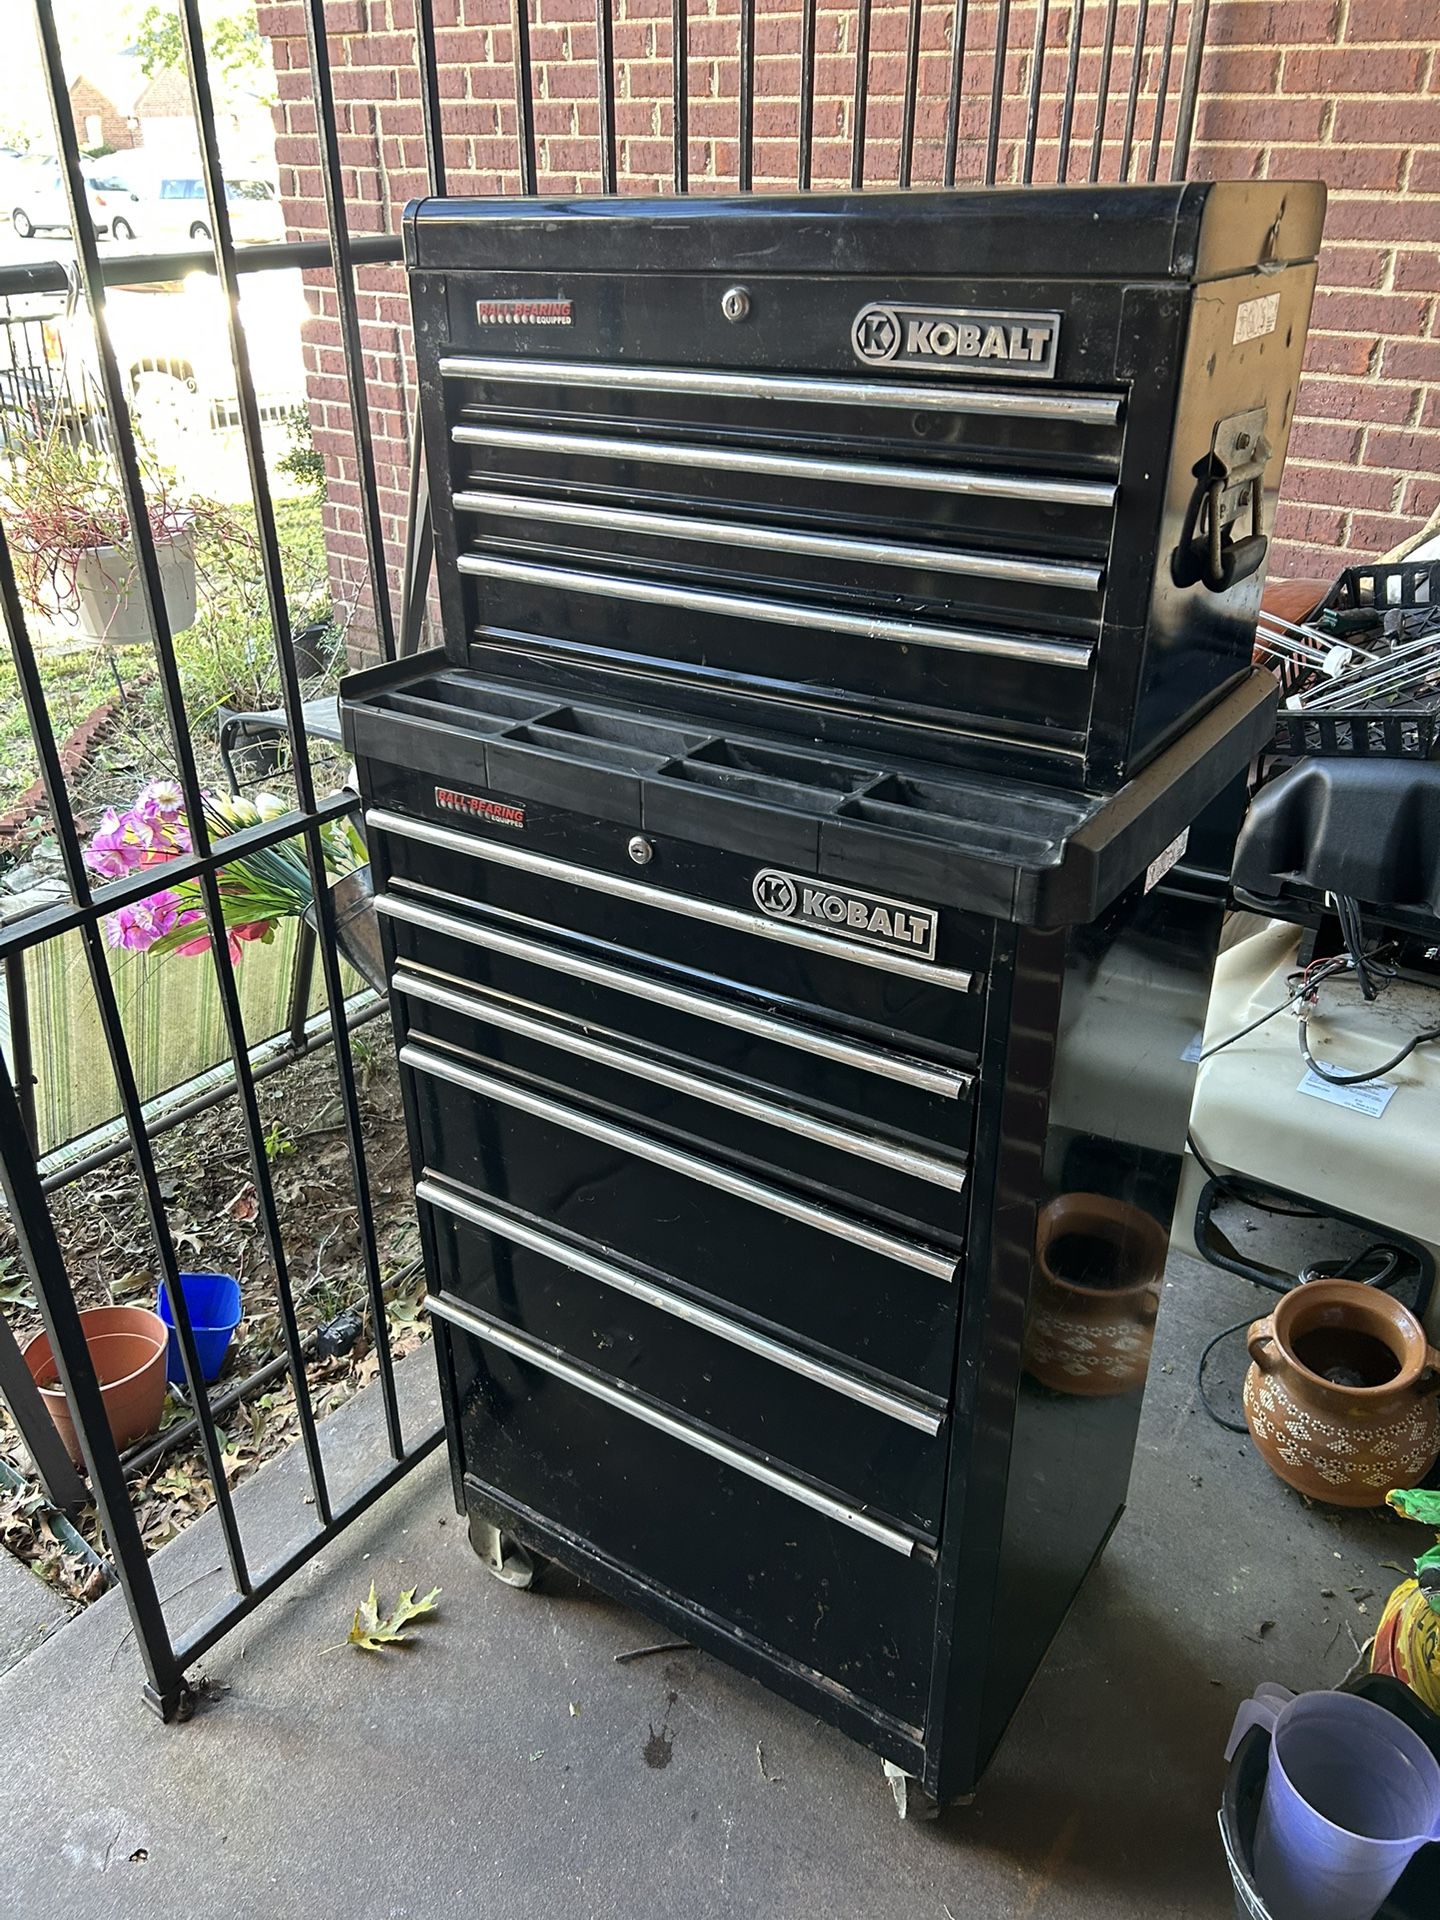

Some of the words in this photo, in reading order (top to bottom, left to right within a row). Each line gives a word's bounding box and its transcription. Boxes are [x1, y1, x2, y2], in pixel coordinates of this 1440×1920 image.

[479, 303, 571, 316] BALL-BEARING
[536, 316, 572, 325] EQUIPPED
[907, 320, 1051, 362] KOBALT
[438, 790, 524, 820] BALL-BEARING
[802, 888, 929, 944] KOBALT
